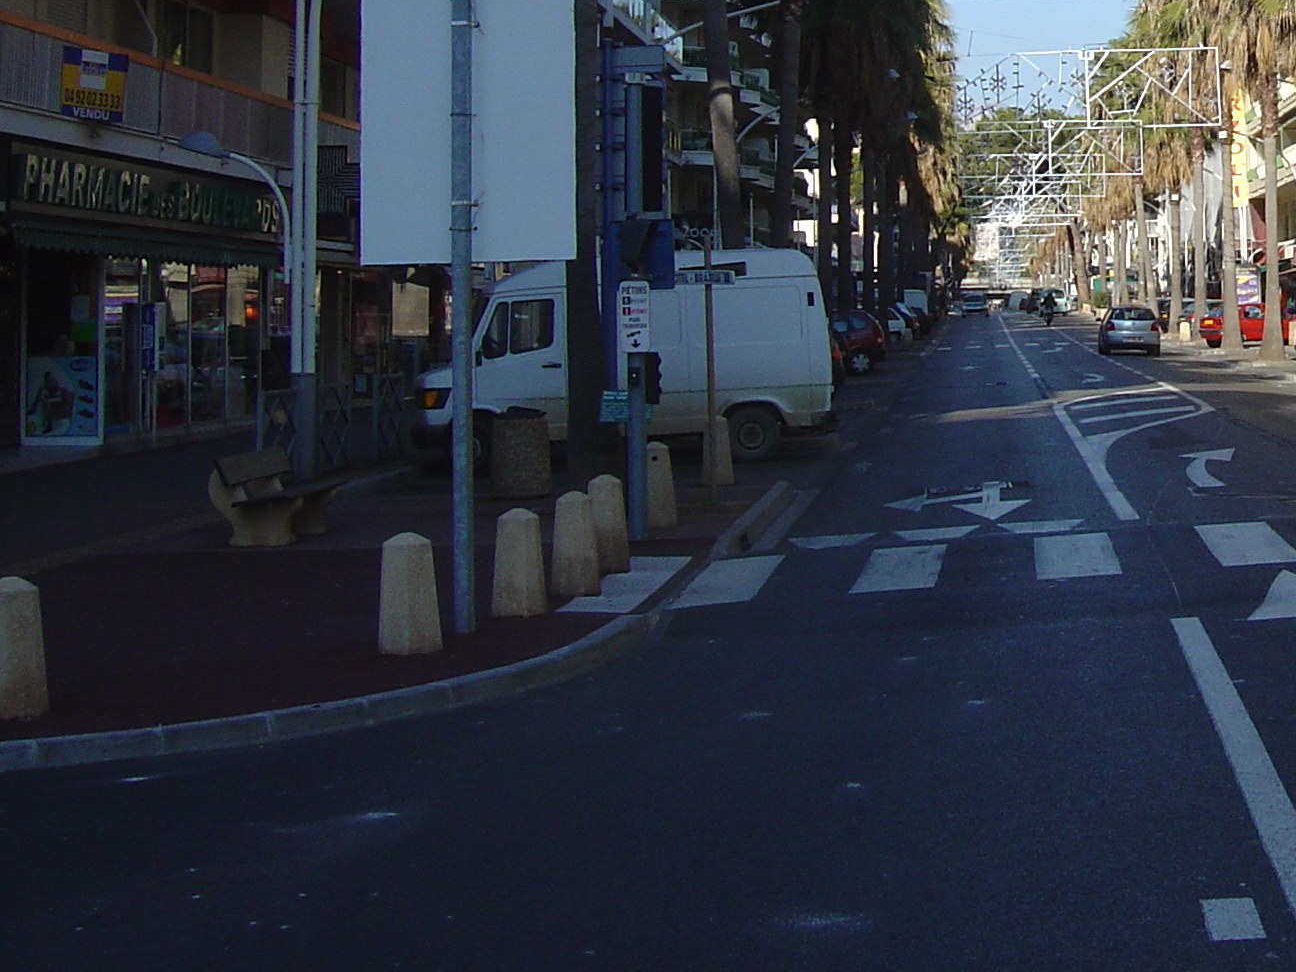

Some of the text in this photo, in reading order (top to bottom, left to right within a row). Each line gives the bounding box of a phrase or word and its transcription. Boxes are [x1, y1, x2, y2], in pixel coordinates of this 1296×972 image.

[73, 107, 110, 121] VENDU
[23, 154, 150, 215] PHARMACIE
[177, 182, 280, 233] BOULEVADS
